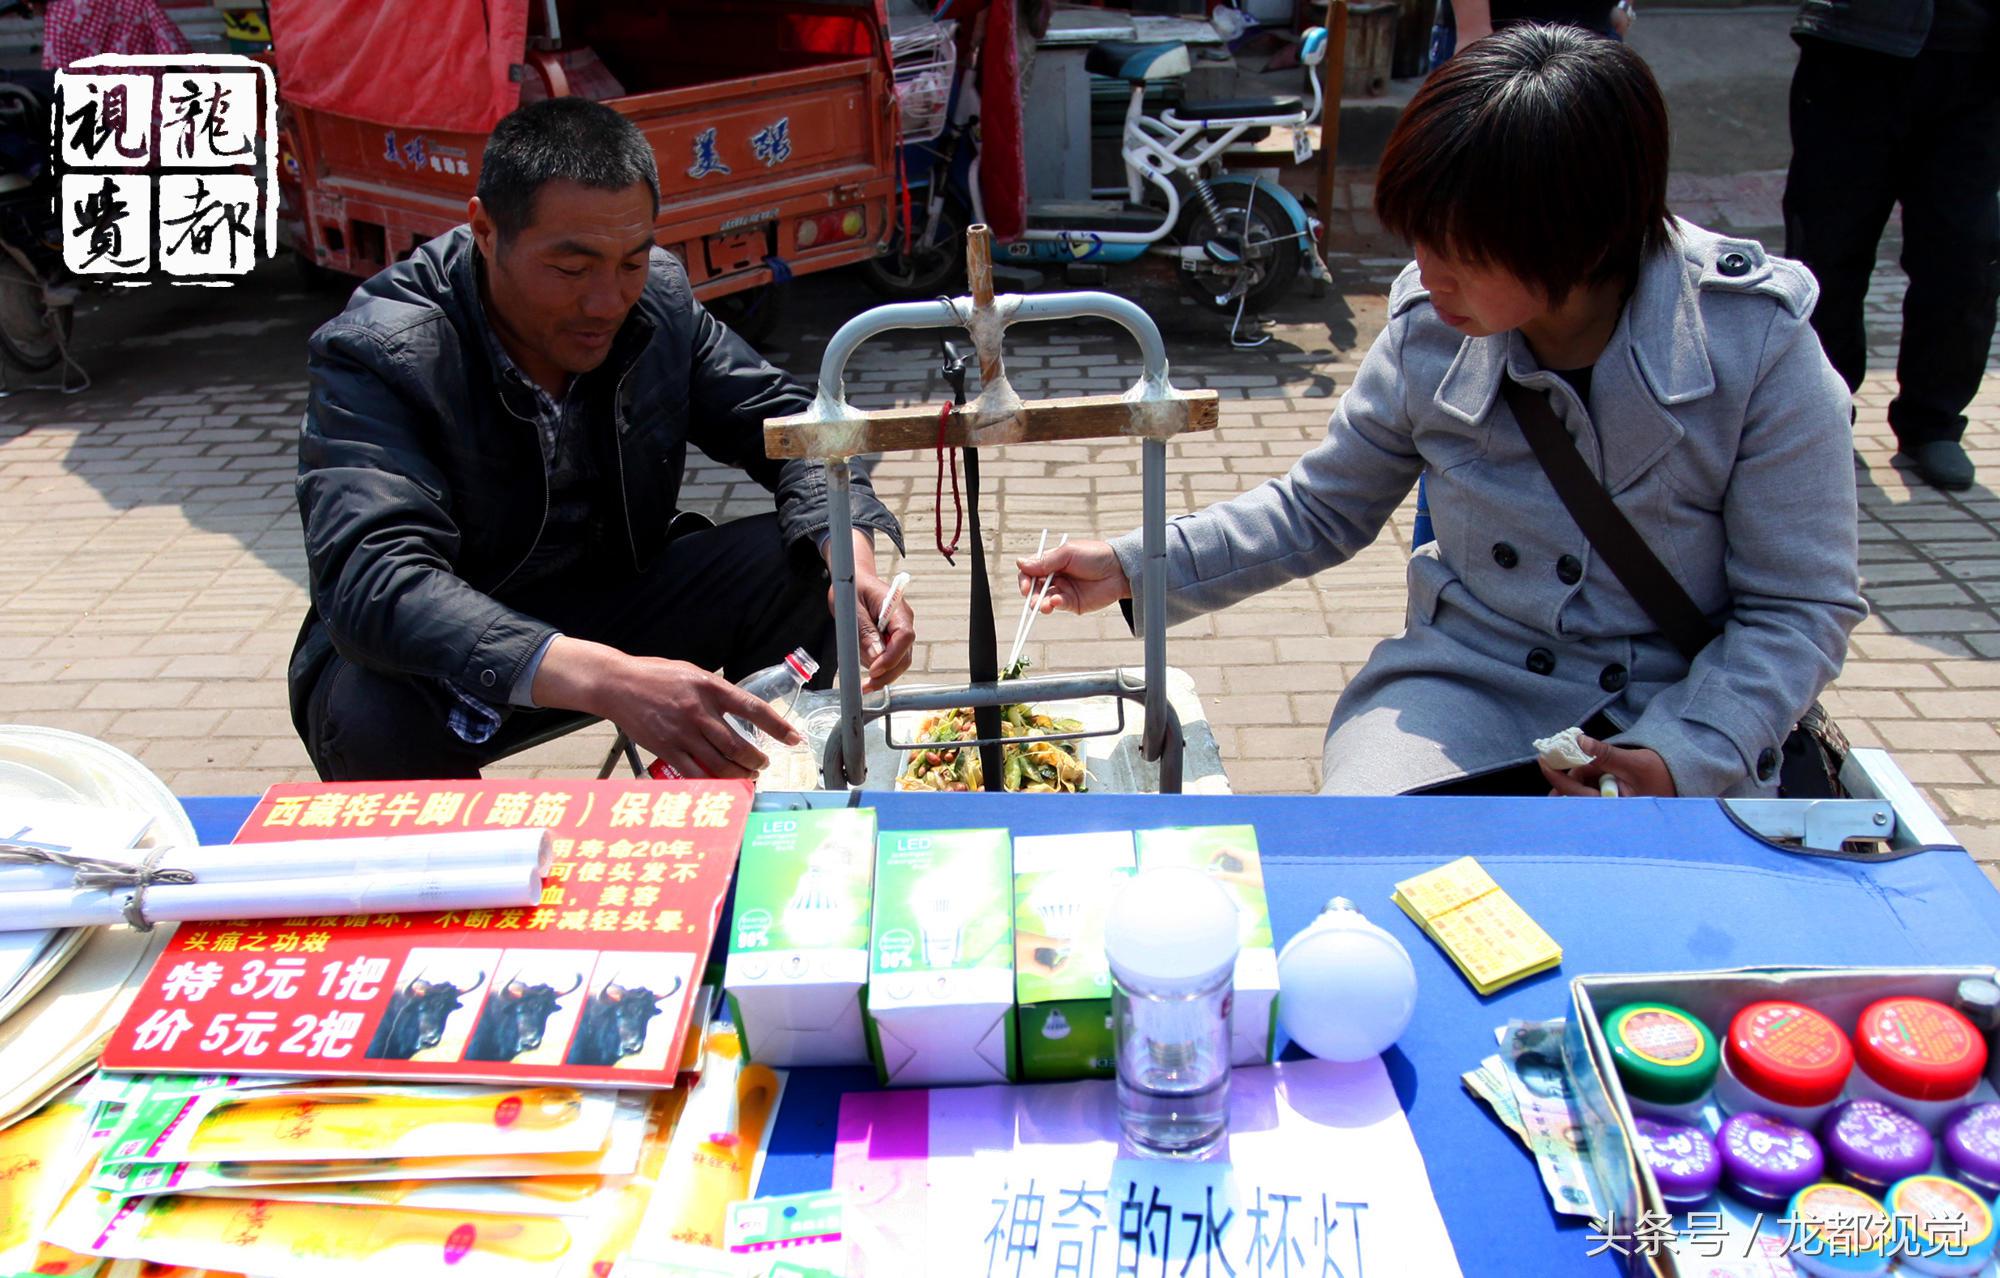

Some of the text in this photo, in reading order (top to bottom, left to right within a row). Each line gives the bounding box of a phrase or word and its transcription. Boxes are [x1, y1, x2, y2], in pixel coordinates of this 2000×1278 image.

[762, 820, 797, 834] LED
[897, 837, 932, 851] LED
[548, 862, 700, 883] 可使头发不
[181, 931, 333, 953] 头痛之功效
[161, 955, 392, 1002] 特 3元 1把
[132, 1008, 366, 1059] 价 5元 2把
[983, 1177, 1370, 1278] 神奇的水杯灯
